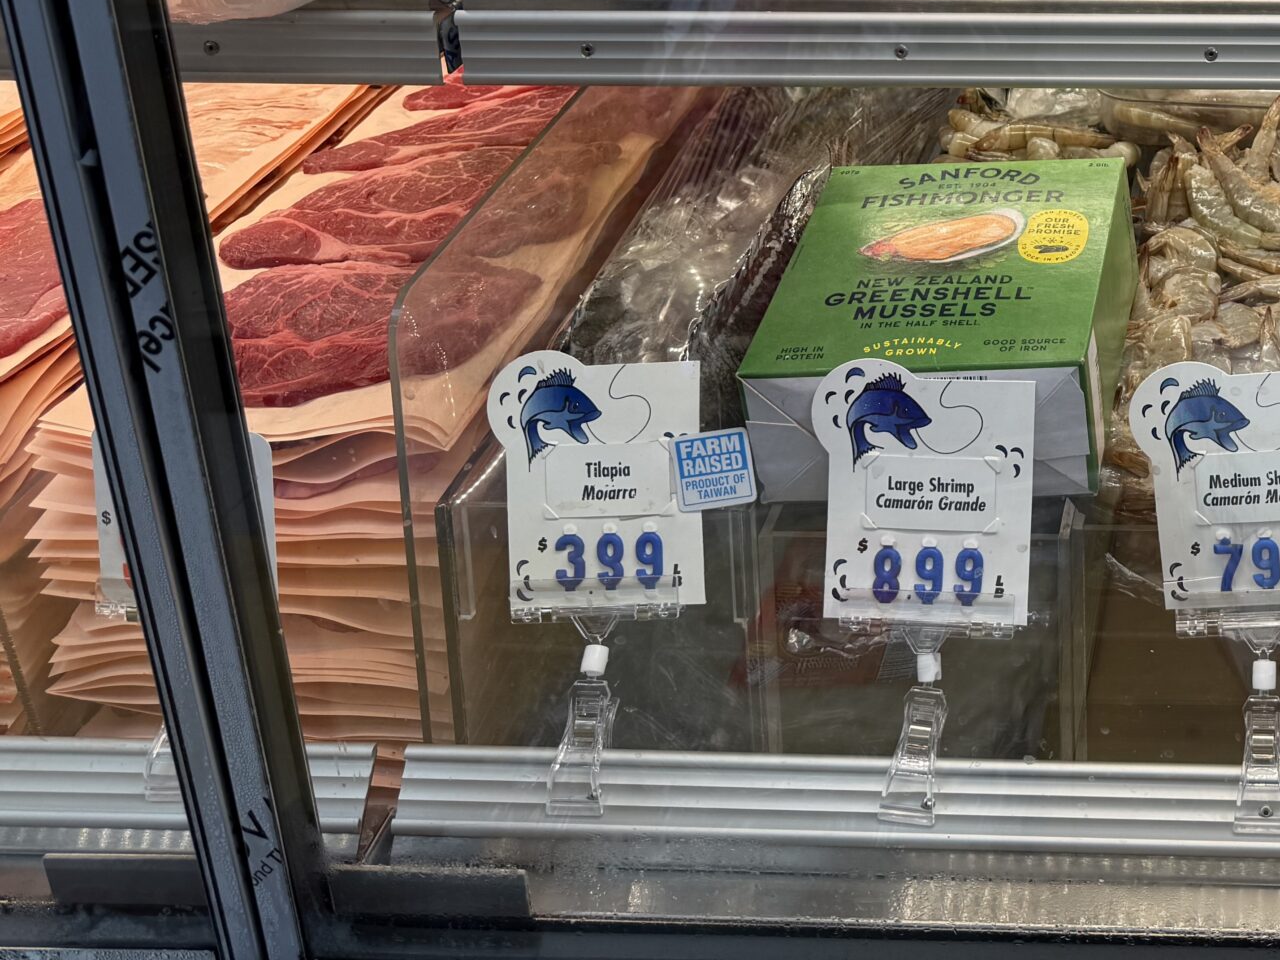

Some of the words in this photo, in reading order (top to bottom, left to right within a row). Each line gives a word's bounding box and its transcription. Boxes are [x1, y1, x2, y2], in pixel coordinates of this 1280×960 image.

[899, 167, 1041, 190] SANFORD
[861, 190, 1065, 210] FISHMONGER
[856, 276, 908, 289] NEW
[914, 274, 1013, 286] ZEALAND
[853, 302, 997, 321] MUSSELS
[942, 319, 981, 327] SHELL
[863, 336, 964, 353] SUSTAINABLY
[1021, 337, 1067, 345] SOURCE
[776, 353, 825, 361] PROTEIN
[780, 346, 808, 354] HIGH
[885, 347, 937, 357] GROWN
[679, 435, 741, 459] FARM
[585, 461, 631, 481] Tilapia
[682, 454, 743, 477] RAISED
[685, 475, 731, 491] PRODUCT
[733, 473, 746, 484] OF
[887, 476, 924, 495] Large
[929, 478, 975, 496] Shrimp
[1209, 473, 1261, 489] Medium
[697, 485, 737, 500] TAIWAN
[1203, 491, 1260, 507] Camarón
[876, 493, 933, 510] Camarón
[938, 496, 986, 512] Grande
